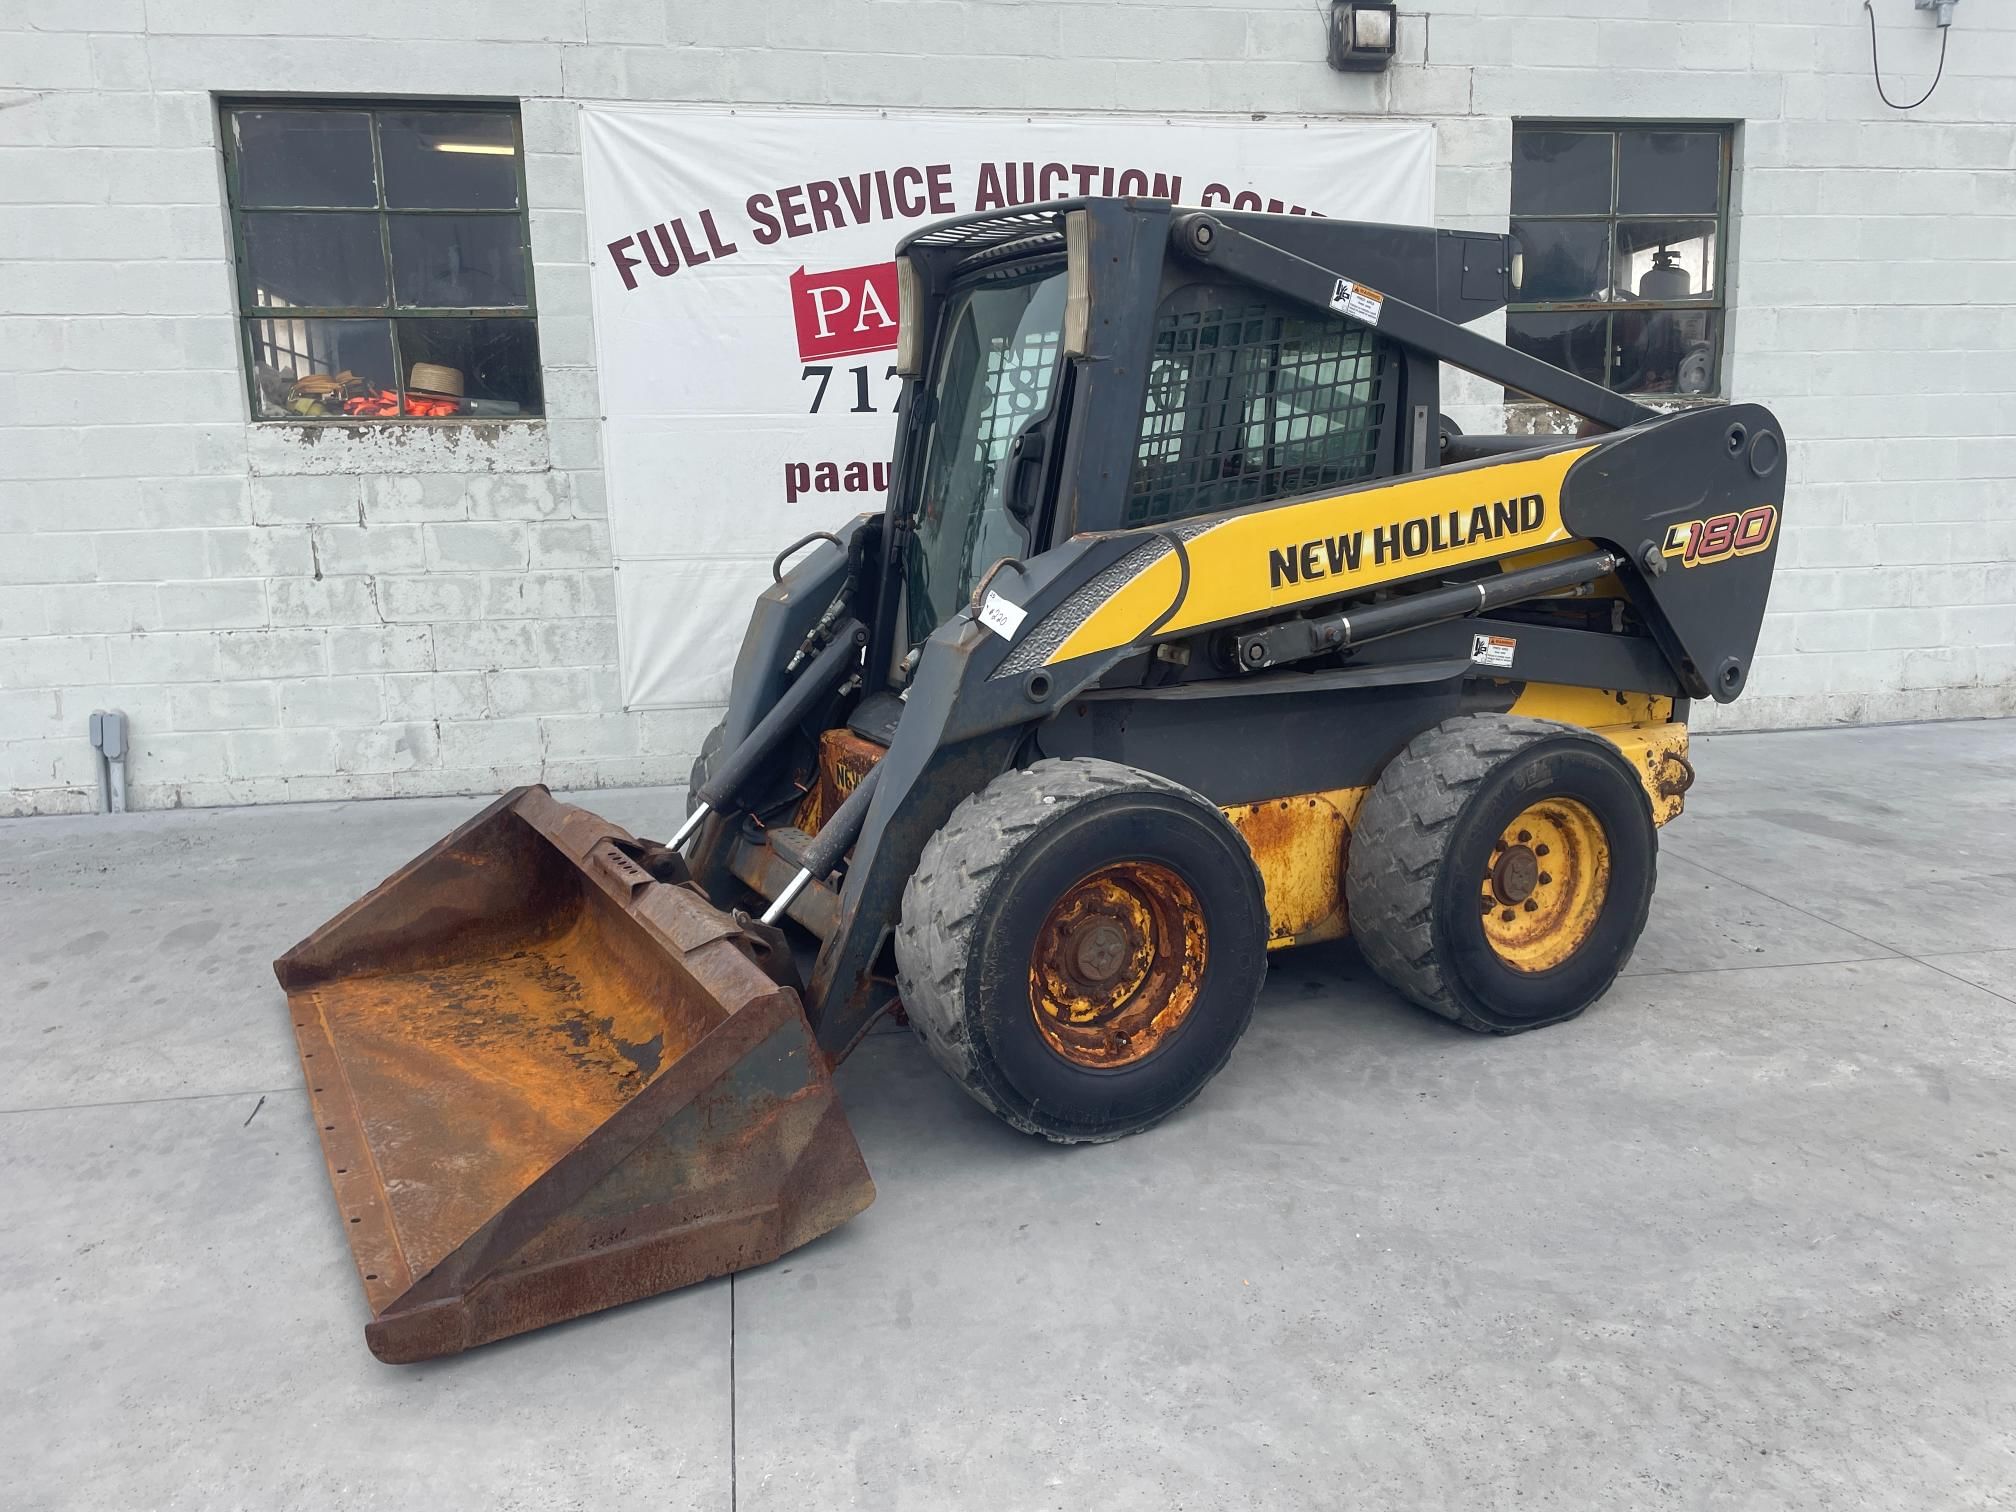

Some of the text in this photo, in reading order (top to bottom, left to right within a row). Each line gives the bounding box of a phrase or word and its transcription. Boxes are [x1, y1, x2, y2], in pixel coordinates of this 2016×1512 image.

[607, 208, 738, 291] FULL
[746, 163, 956, 246] SERVICE
[975, 162, 1182, 212] AUCTION
[1269, 494, 1545, 588] NEW HOLLAND
[1662, 505, 1777, 567] L180
